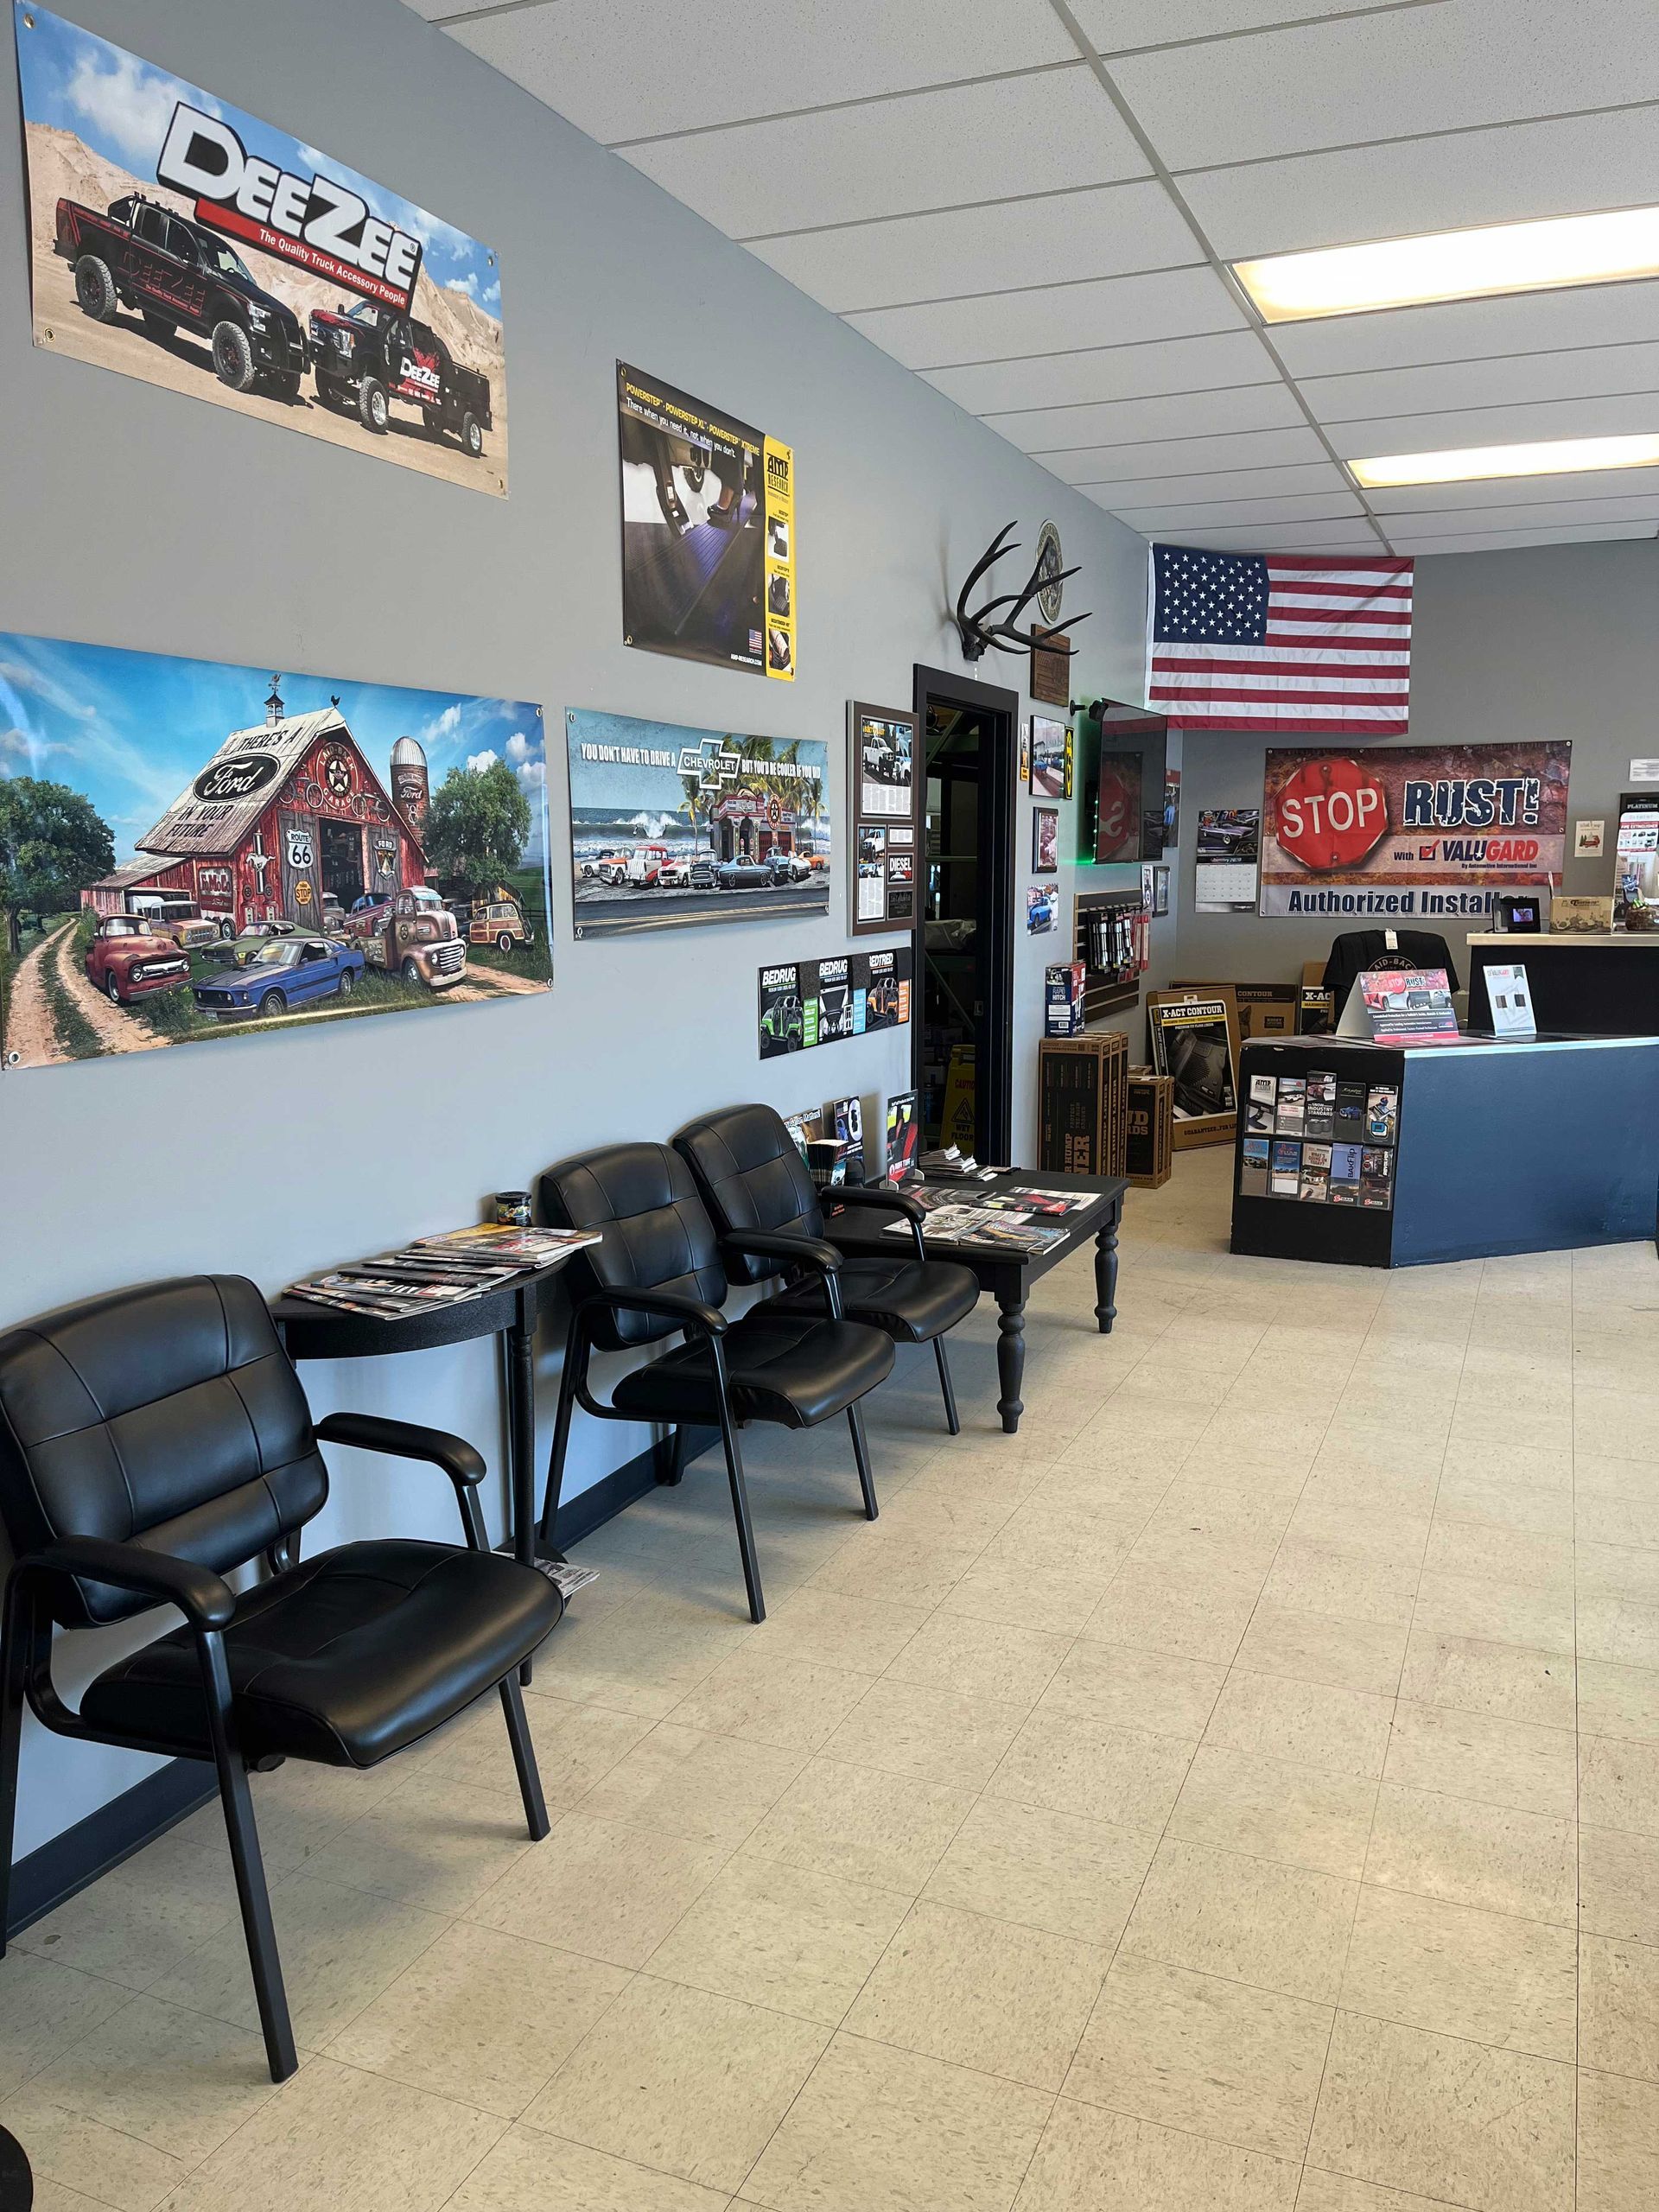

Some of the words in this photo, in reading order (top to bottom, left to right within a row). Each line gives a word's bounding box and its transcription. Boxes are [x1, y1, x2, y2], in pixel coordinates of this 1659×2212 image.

[259, 228, 276, 245] The
[278, 237, 310, 262] Quality
[311, 251, 335, 274] Truck
[335, 265, 378, 296] Accessory
[378, 284, 406, 306] People
[626, 397, 643, 413] There
[643, 408, 659, 421] when
[658, 416, 669, 427] you
[670, 421, 683, 433] need
[690, 430, 699, 441] not
[700, 435, 713, 447] when
[714, 442, 722, 452] you
[665, 403, 698, 424] POWERSTEP
[741, 440, 760, 456] XTREME
[767, 457, 789, 480] AMP
[767, 474, 789, 492] RESEARCH
[238, 730, 289, 752] THERE'S
[285, 727, 302, 745] A
[319, 746, 355, 771] LAID-BACK
[581, 742, 598, 760] YOU
[598, 745, 620, 762] DON'T
[620, 747, 639, 764] HAVE
[639, 748, 651, 765] TO
[650, 750, 671, 767] DRIVE
[671, 752, 676, 767] A
[683, 756, 736, 772] CHEVROLET
[203, 761, 264, 797] Ford
[741, 759, 753, 774] BUT
[753, 760, 769, 775] YOU'D
[769, 761, 777, 776] BE
[777, 762, 797, 778] COOLER
[796, 764, 802, 778] IF
[801, 765, 812, 779] YOU
[812, 766, 821, 779] DID
[323, 786, 356, 807] GARAGE
[400, 786, 423, 800] Ford
[178, 806, 194, 821] IN
[194, 804, 234, 821] YOUR
[1281, 786, 1379, 839] STOP
[1402, 778, 1541, 828] RUST!
[166, 823, 214, 838] FUTURE
[290, 833, 310, 842] ROUTE
[291, 844, 311, 865] 66
[378, 840, 393, 849] FORD
[1393, 851, 1414, 861] With
[1441, 839, 1540, 862] VALUGARD
[889, 857, 912, 872] DIESEL
[296, 887, 311, 899] STOP
[1287, 889, 1417, 914] Authorized
[762, 967, 797, 986] BEDRUG
[819, 959, 849, 976] BEDRUG
[1186, 1005, 1223, 1017] CONTOUR
[956, 1123, 970, 1132] WET
[1064, 1133, 1073, 1160] HUMP
